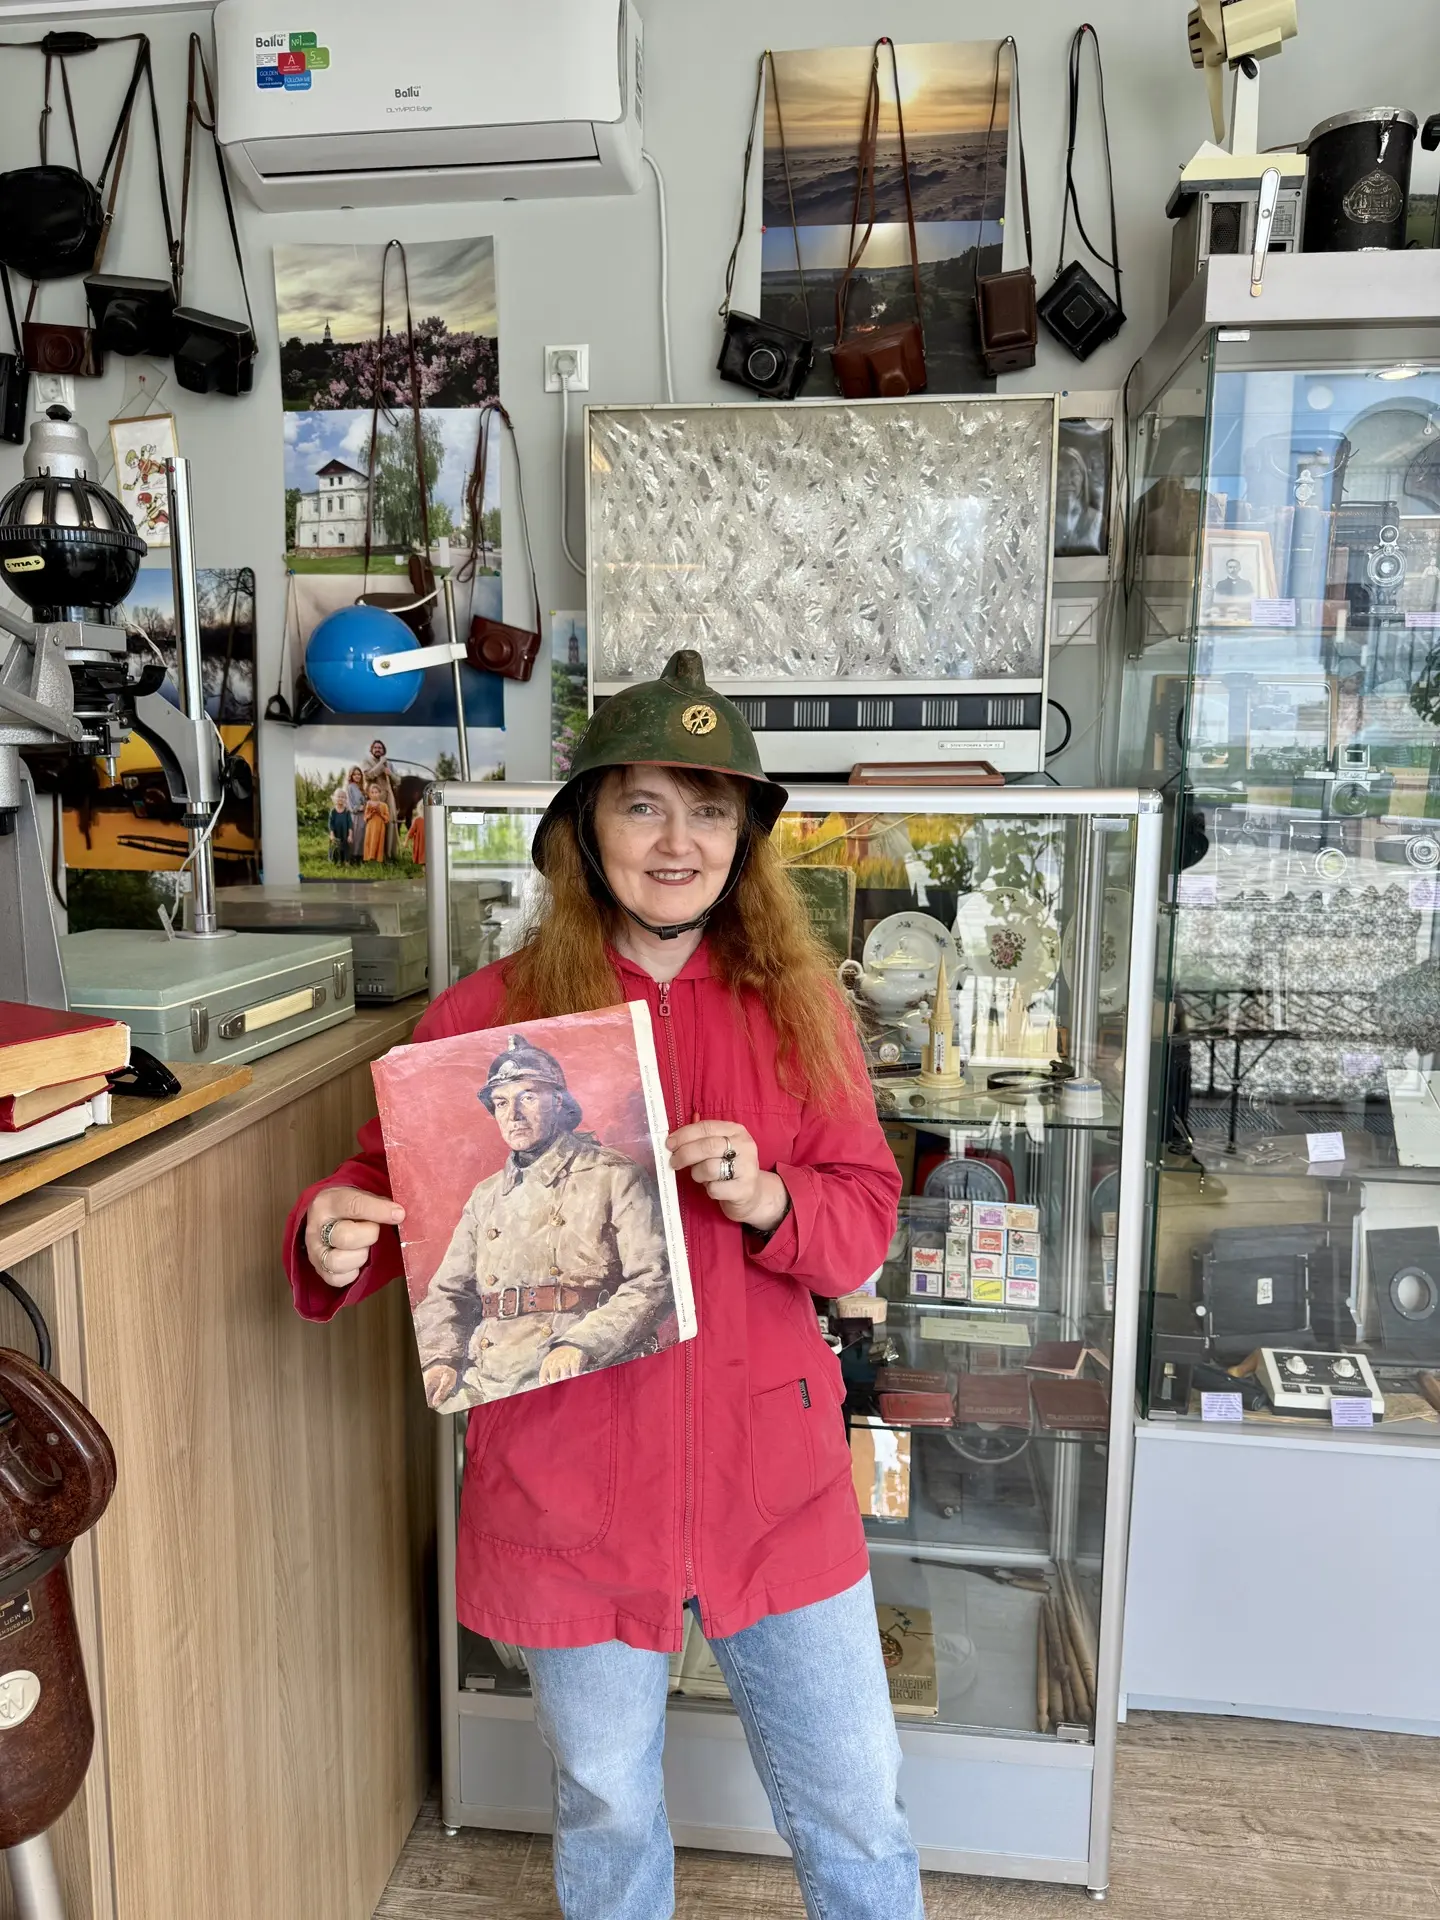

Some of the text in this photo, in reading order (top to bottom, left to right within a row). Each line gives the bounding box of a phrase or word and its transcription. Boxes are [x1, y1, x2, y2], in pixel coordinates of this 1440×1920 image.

[256, 34, 283, 48] Ballu
[310, 51, 317, 61] 5
[395, 86, 419, 98] Ballu
[889, 1679, 932, 1690] КОДЕЛИЕ
